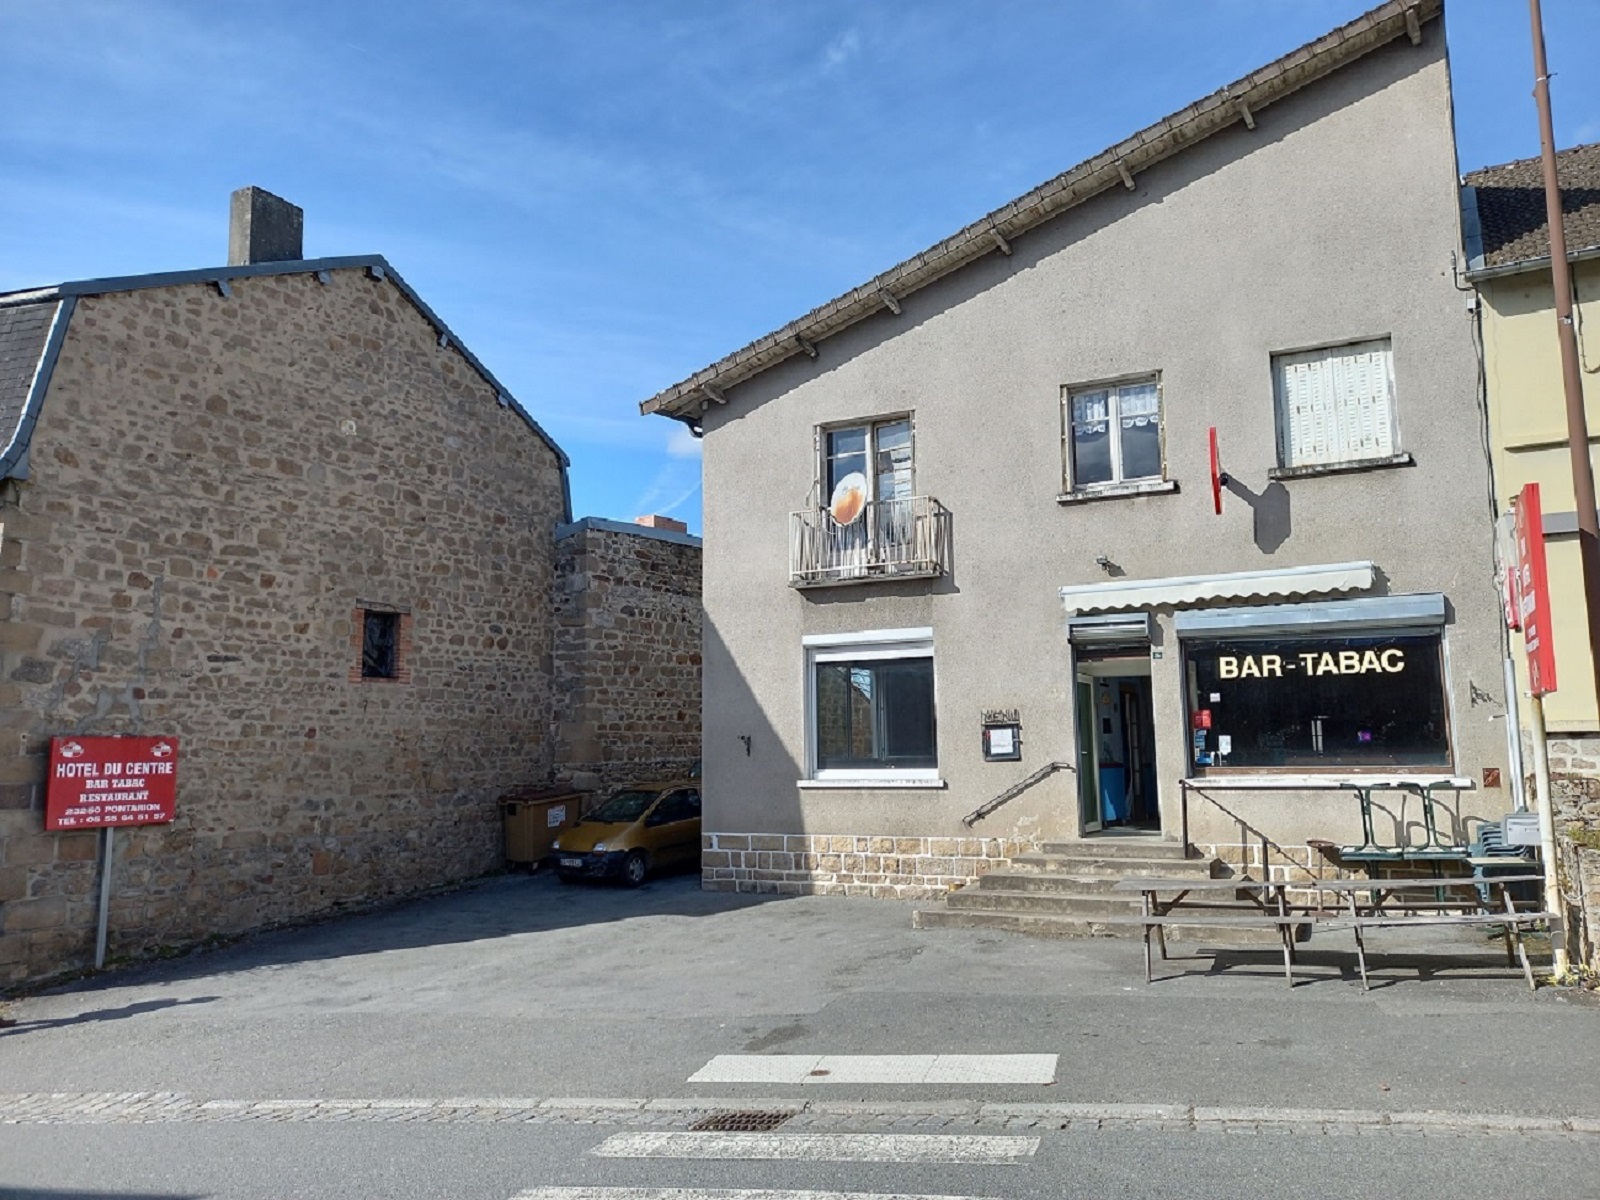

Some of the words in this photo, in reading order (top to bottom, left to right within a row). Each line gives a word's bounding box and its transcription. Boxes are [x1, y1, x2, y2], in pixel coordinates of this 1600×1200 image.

[56, 763, 99, 778] HOTEL
[104, 763, 122, 775] DU
[126, 762, 173, 775] CENTRE
[85, 779, 108, 789] BAR
[112, 779, 145, 788] TABAC
[80, 791, 149, 802] RESTAURANT
[105, 804, 160, 813] PONTARION
